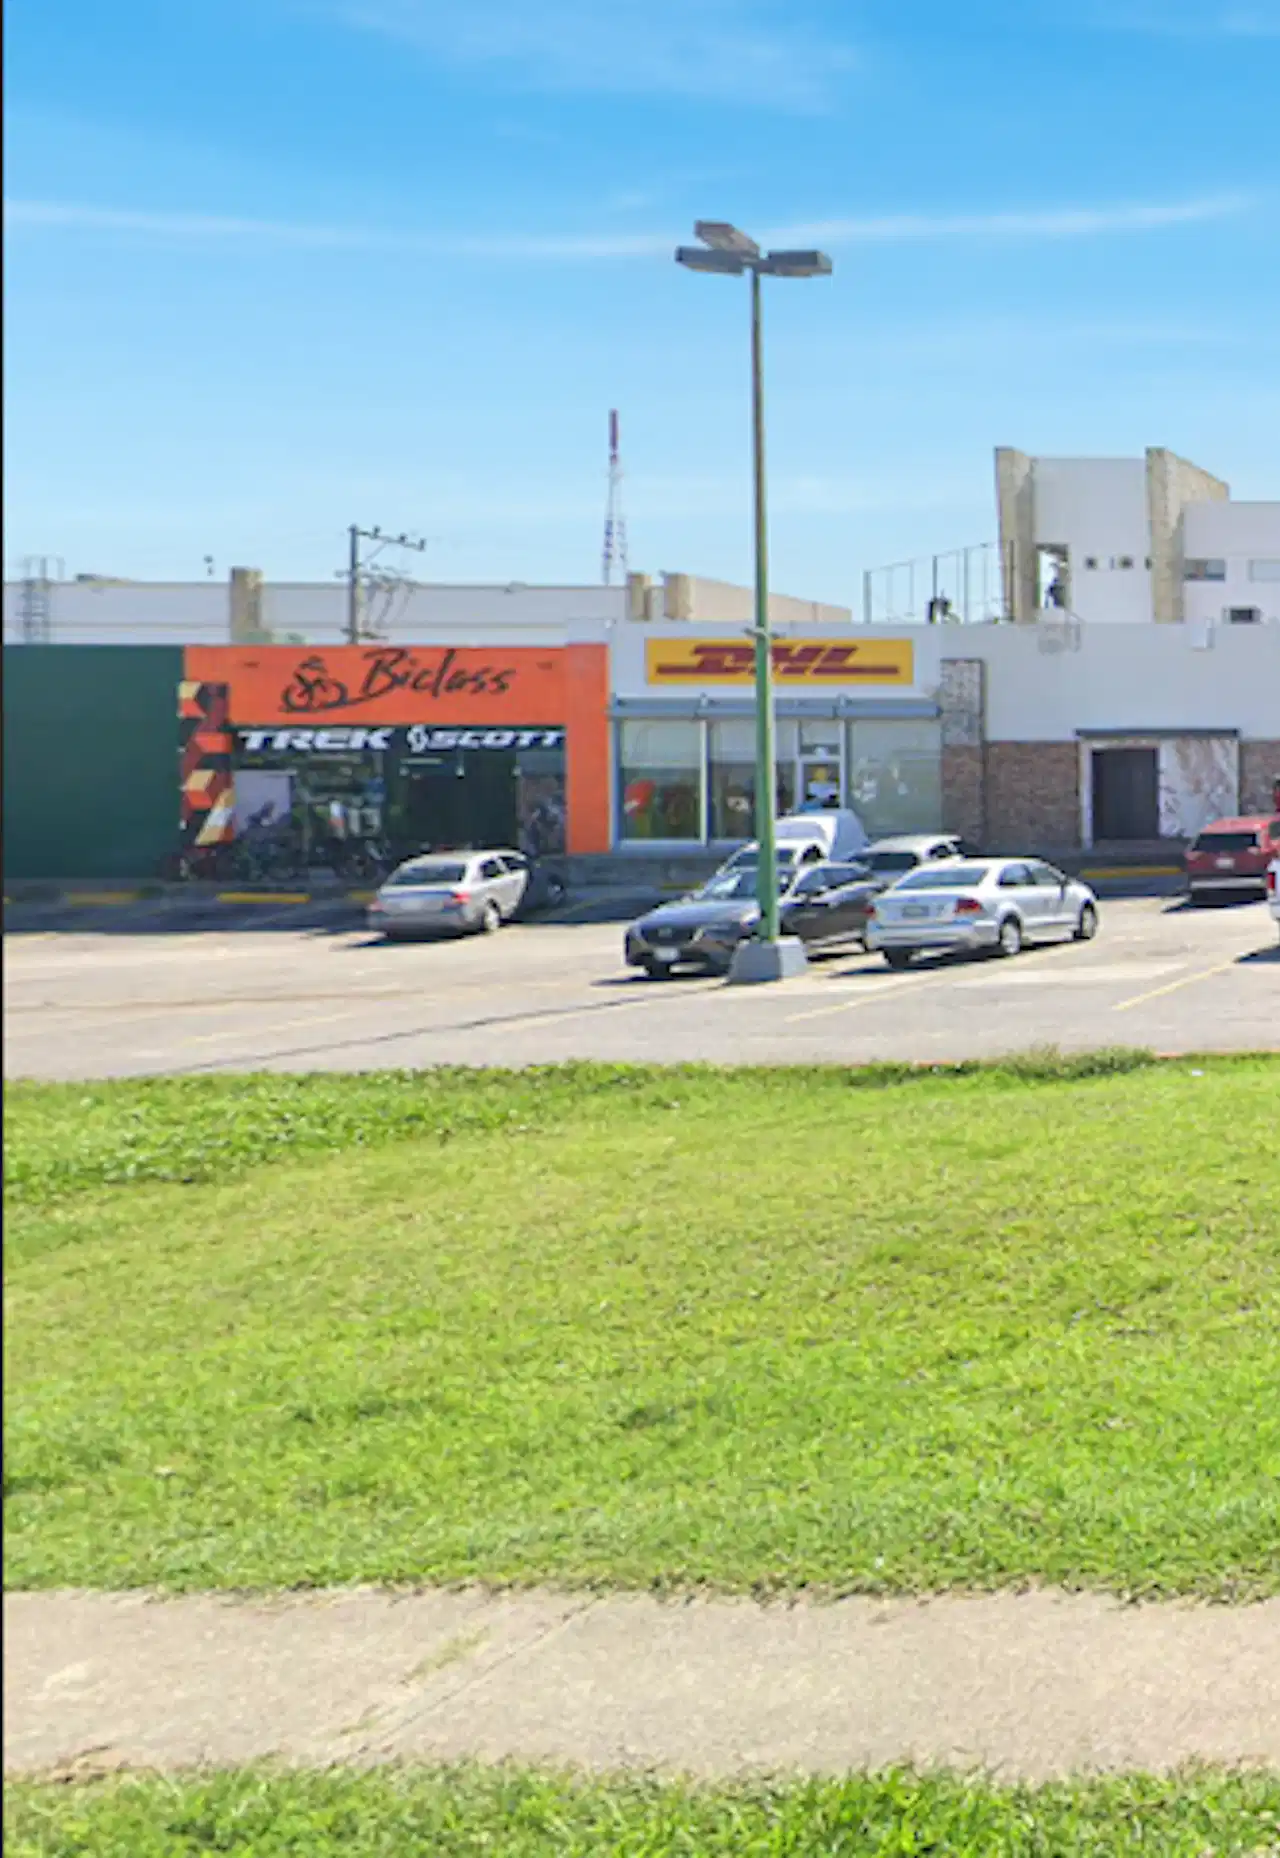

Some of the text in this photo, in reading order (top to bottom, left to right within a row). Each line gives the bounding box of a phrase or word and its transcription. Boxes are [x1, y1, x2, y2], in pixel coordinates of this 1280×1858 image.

[691, 645, 859, 675] DHL
[238, 727, 396, 750] TREK
[427, 730, 566, 750] SCOTT
